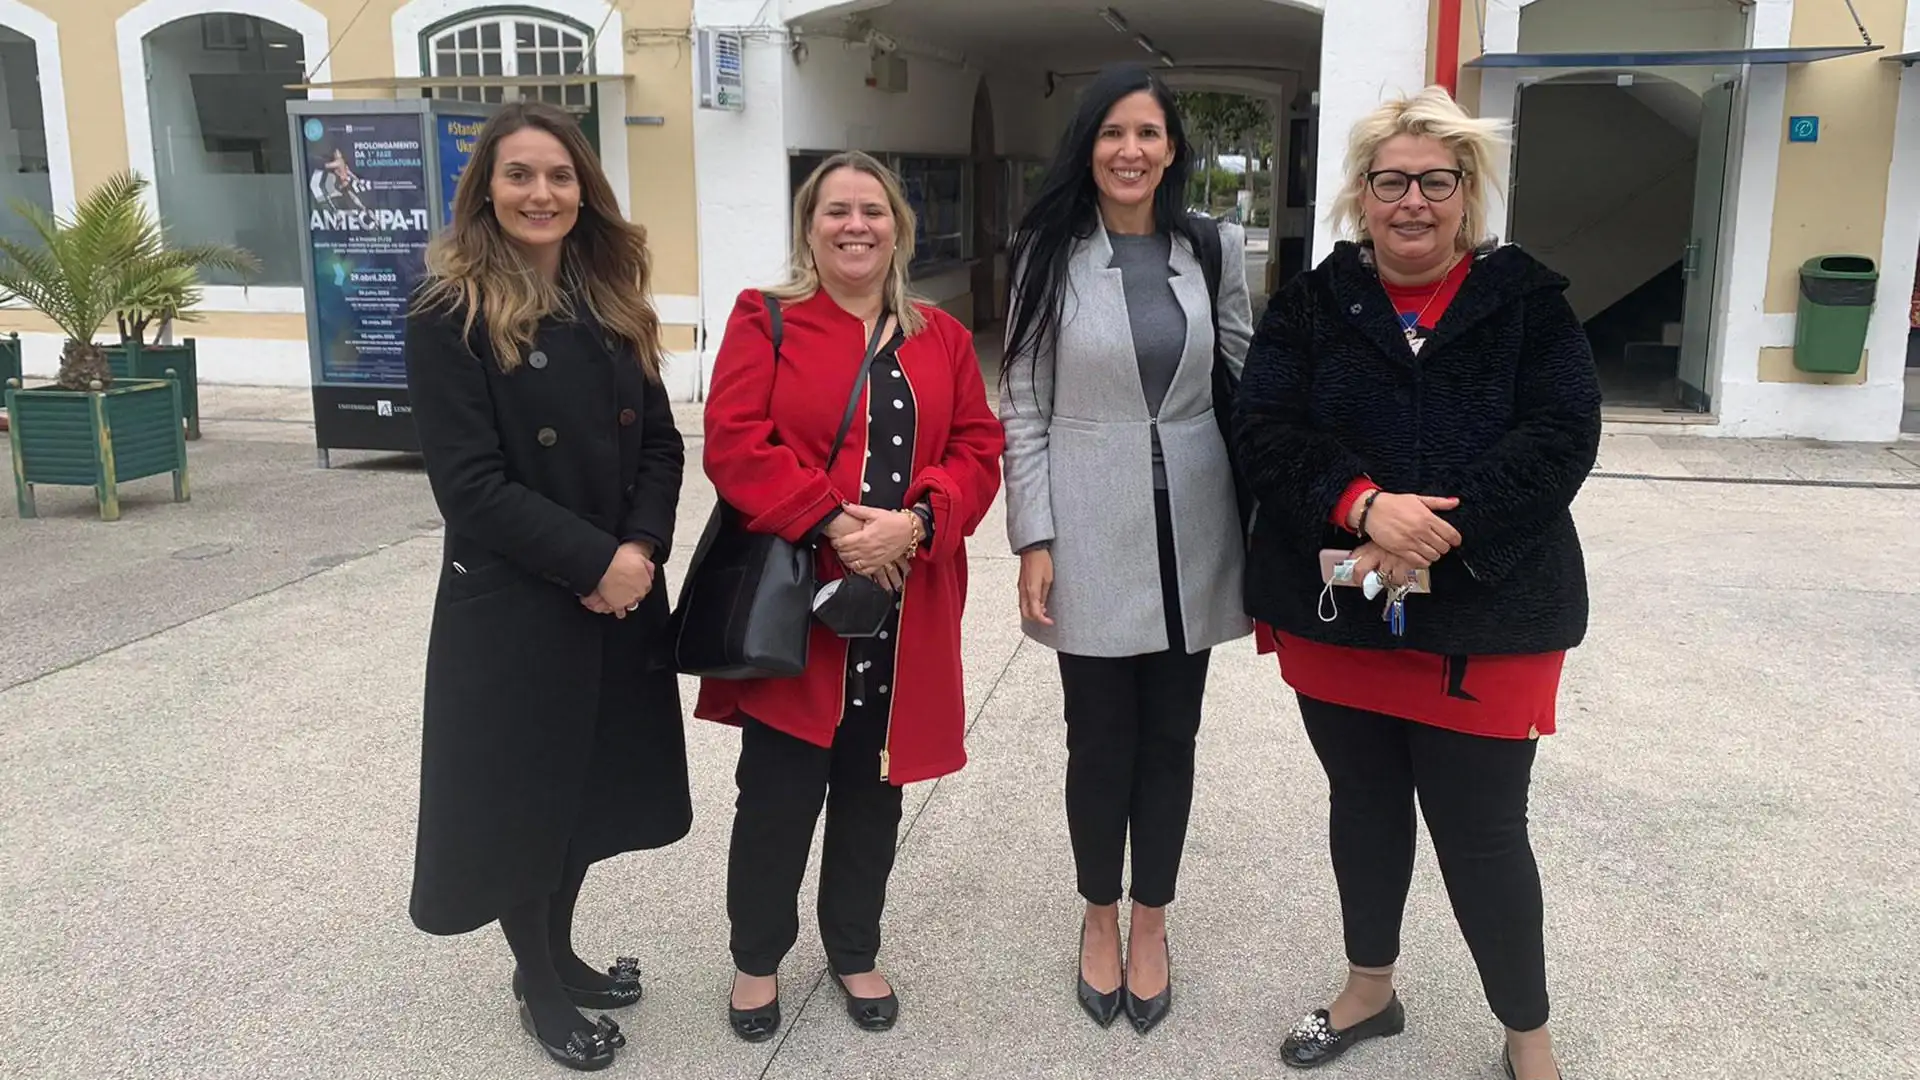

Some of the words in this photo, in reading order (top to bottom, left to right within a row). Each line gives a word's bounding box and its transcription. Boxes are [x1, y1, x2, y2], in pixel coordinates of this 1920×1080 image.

[354, 141, 419, 150] PROLONGAMENTO
[355, 150, 365, 159] DA
[376, 150, 391, 158] FASE
[367, 159, 421, 168] CANDIDATURAS
